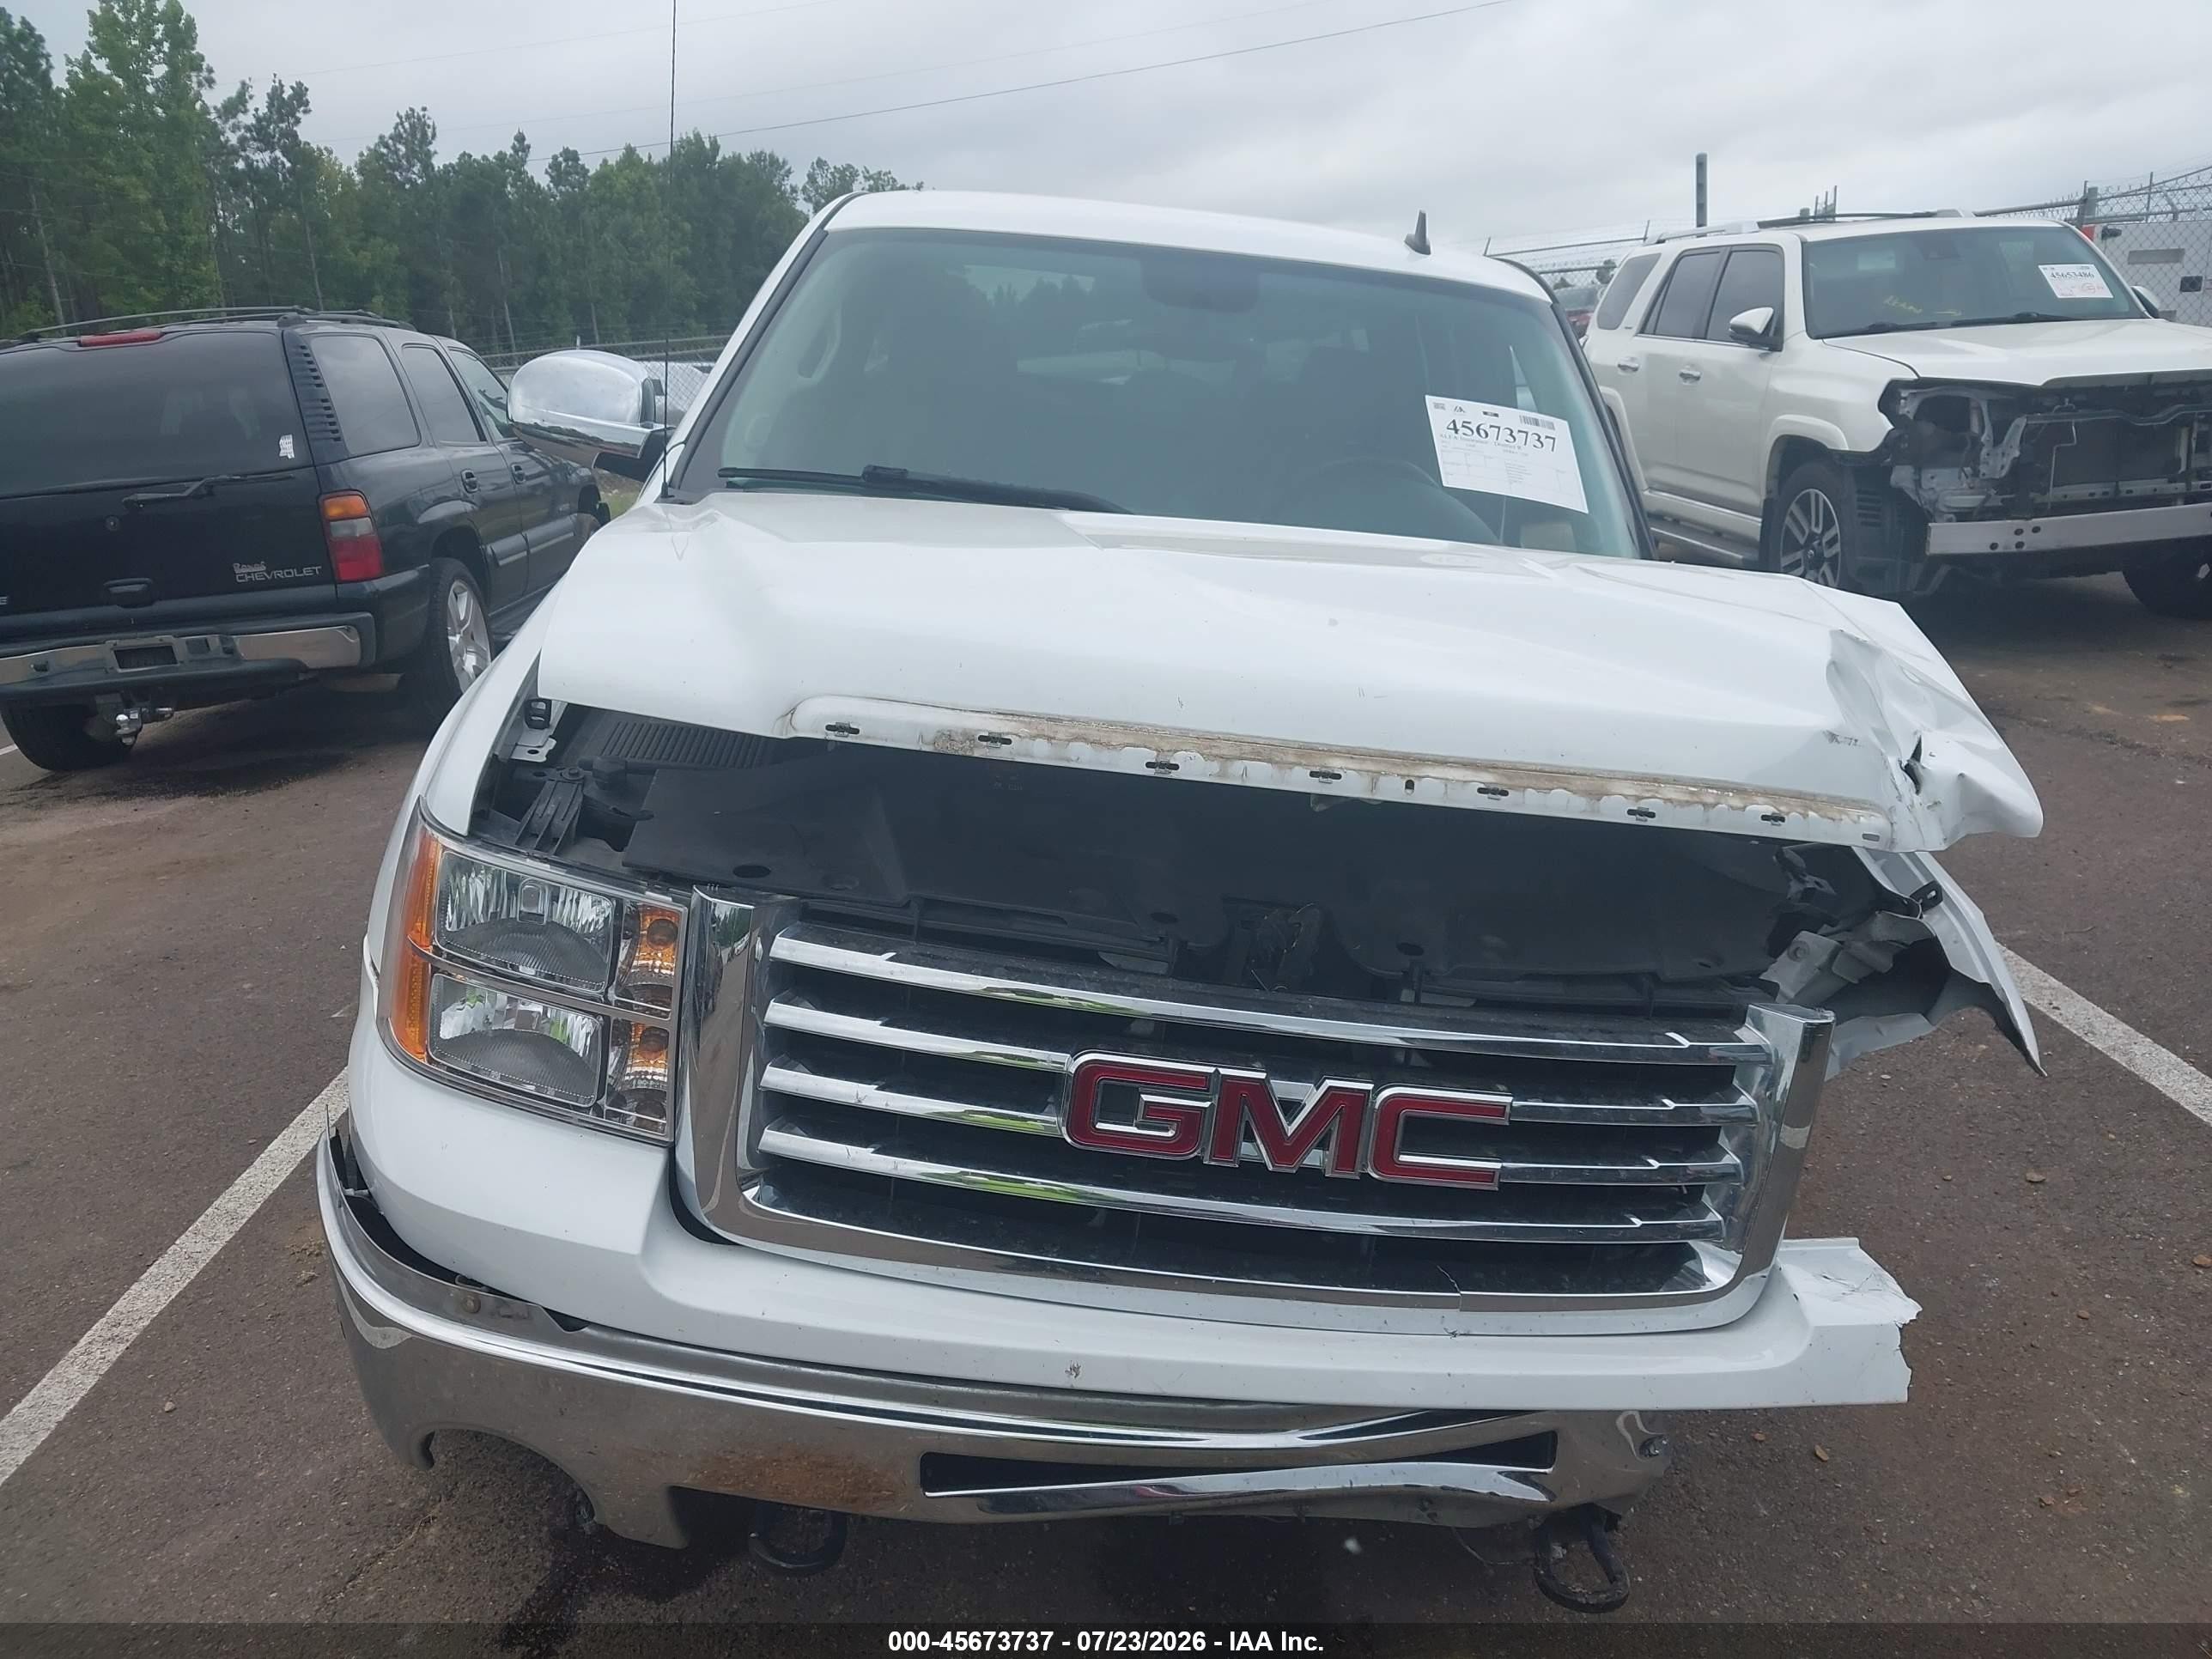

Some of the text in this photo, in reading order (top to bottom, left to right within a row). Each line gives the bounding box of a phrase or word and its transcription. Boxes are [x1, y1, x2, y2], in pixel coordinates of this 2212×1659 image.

[1446, 418, 1557, 453] 45673737
[235, 566, 322, 582] CHEVROLET
[1060, 1049, 1514, 1191] GMC
